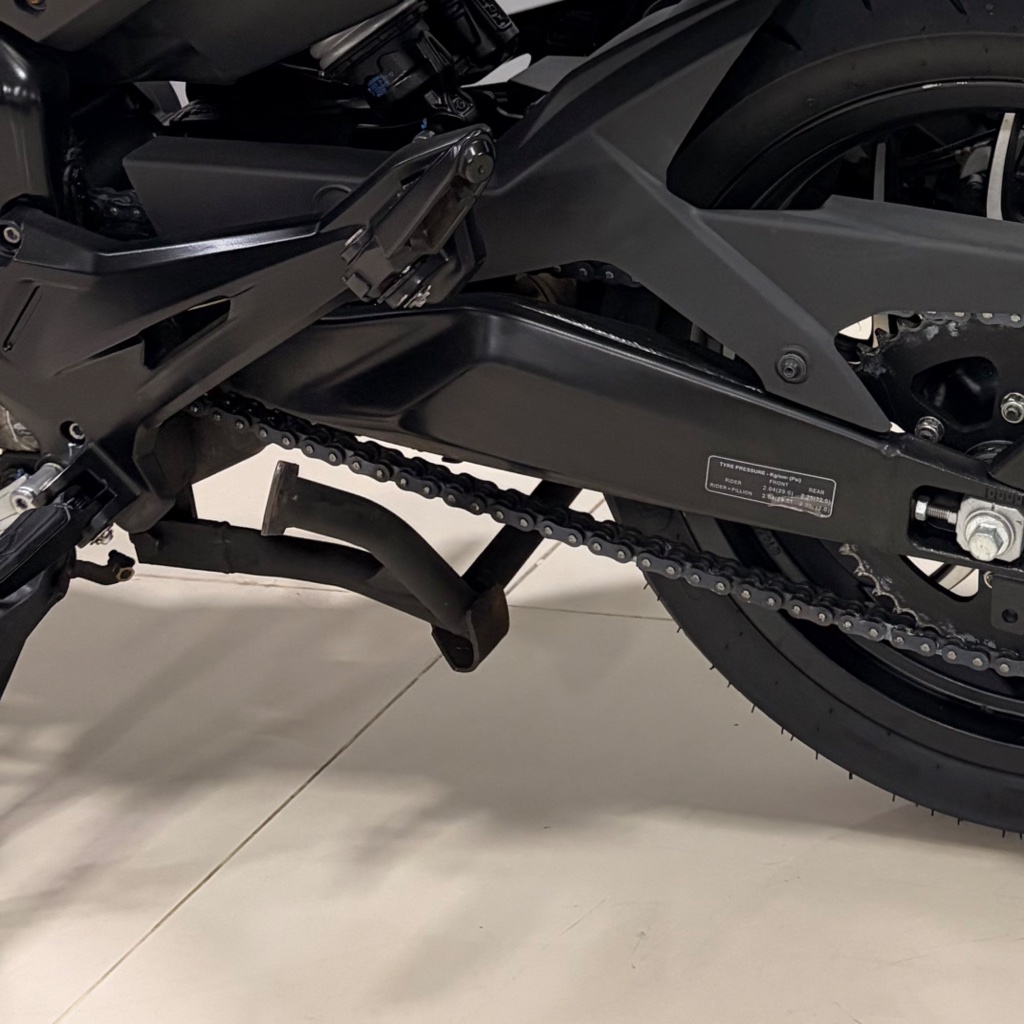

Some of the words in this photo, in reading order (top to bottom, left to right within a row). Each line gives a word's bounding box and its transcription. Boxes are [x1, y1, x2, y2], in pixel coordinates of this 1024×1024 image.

[719, 461, 734, 470] TYRE
[735, 464, 766, 476] PRESSURE
[724, 477, 742, 486] RIDER
[769, 479, 789, 487] FRONT
[709, 482, 727, 490] RIDER
[731, 487, 753, 496] PILLION
[808, 487, 825, 496] REAR
